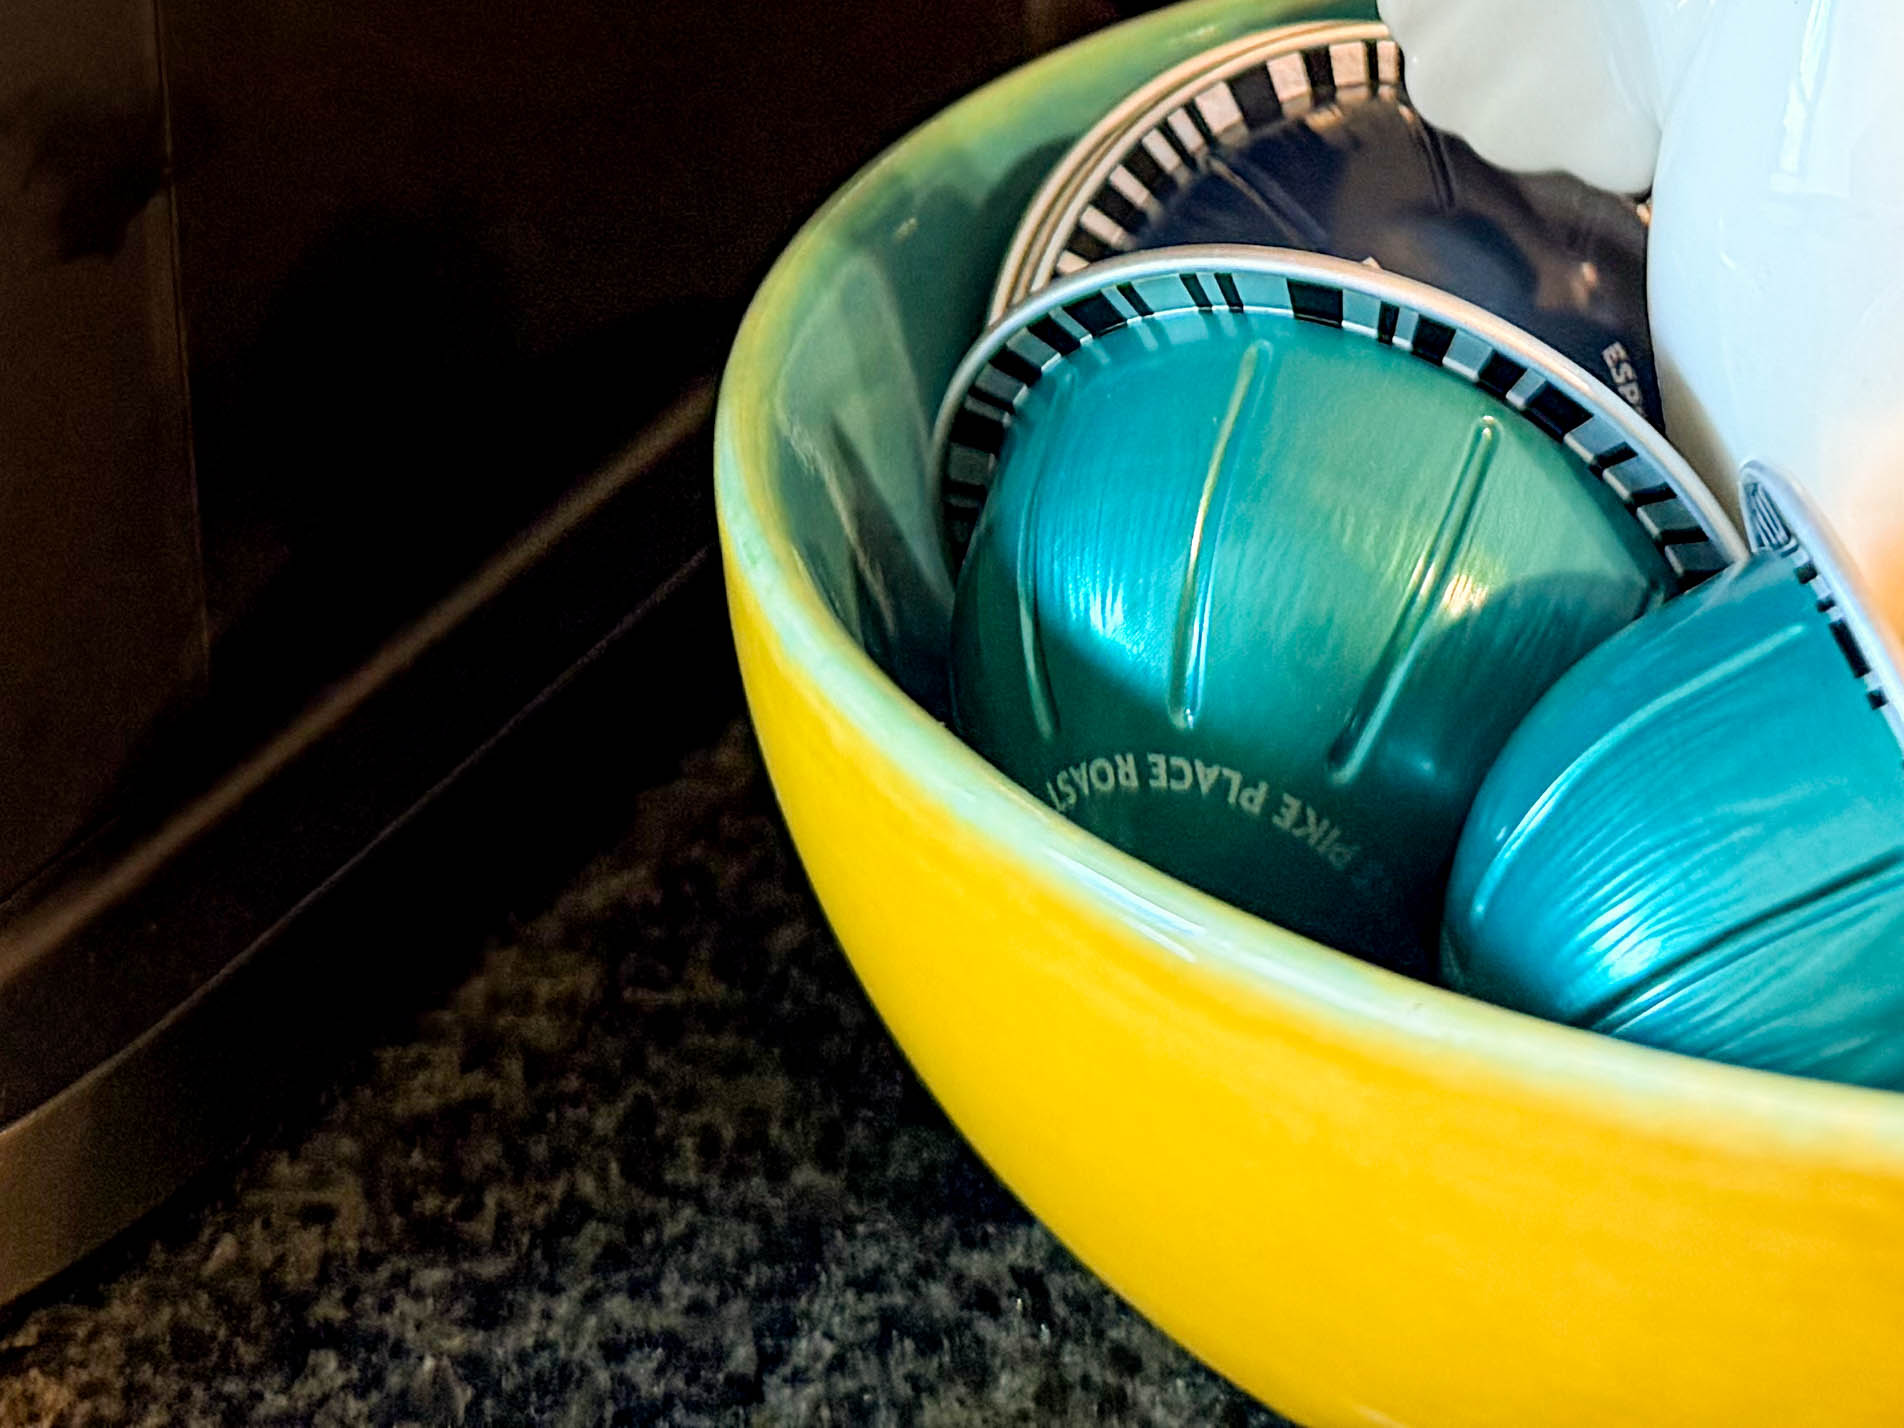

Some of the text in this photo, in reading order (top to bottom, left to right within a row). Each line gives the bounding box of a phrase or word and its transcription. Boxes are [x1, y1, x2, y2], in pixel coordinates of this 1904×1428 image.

[1602, 341, 1646, 418] ESP
[1147, 752, 1270, 816] PLACE
[1272, 793, 1361, 871] PIKE
